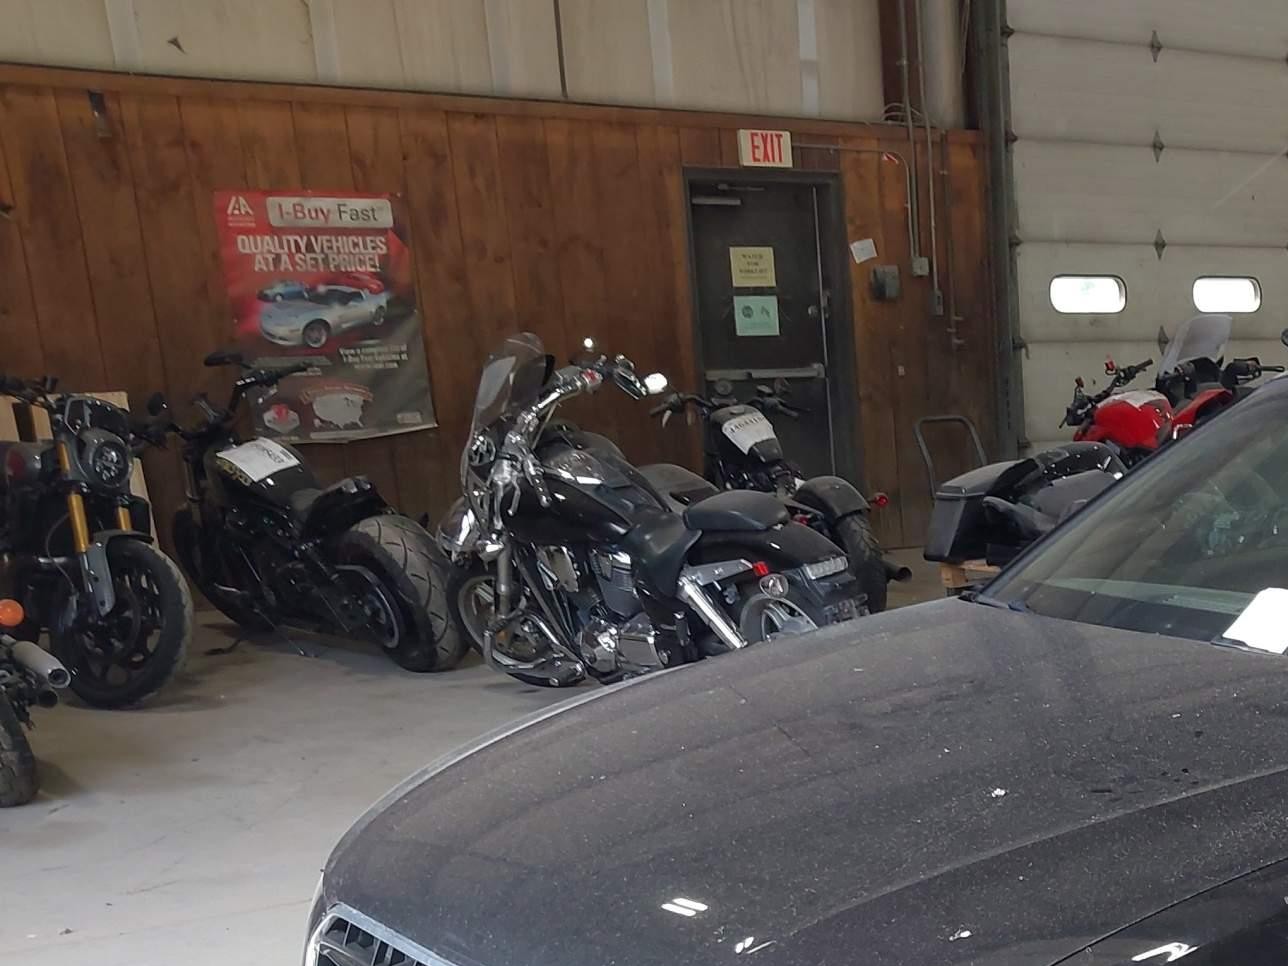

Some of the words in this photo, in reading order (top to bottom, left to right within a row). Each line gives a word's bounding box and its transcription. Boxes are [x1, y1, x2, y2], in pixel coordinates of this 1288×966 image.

[750, 132, 783, 163] EXIT
[277, 203, 331, 223] I-Buy
[337, 204, 378, 222] Fast
[237, 235, 308, 254] QUALITY
[311, 236, 388, 254] VEHICLES
[254, 254, 277, 272] AT
[279, 254, 294, 272] A
[296, 254, 328, 272] SET
[329, 254, 381, 272] PRICE!
